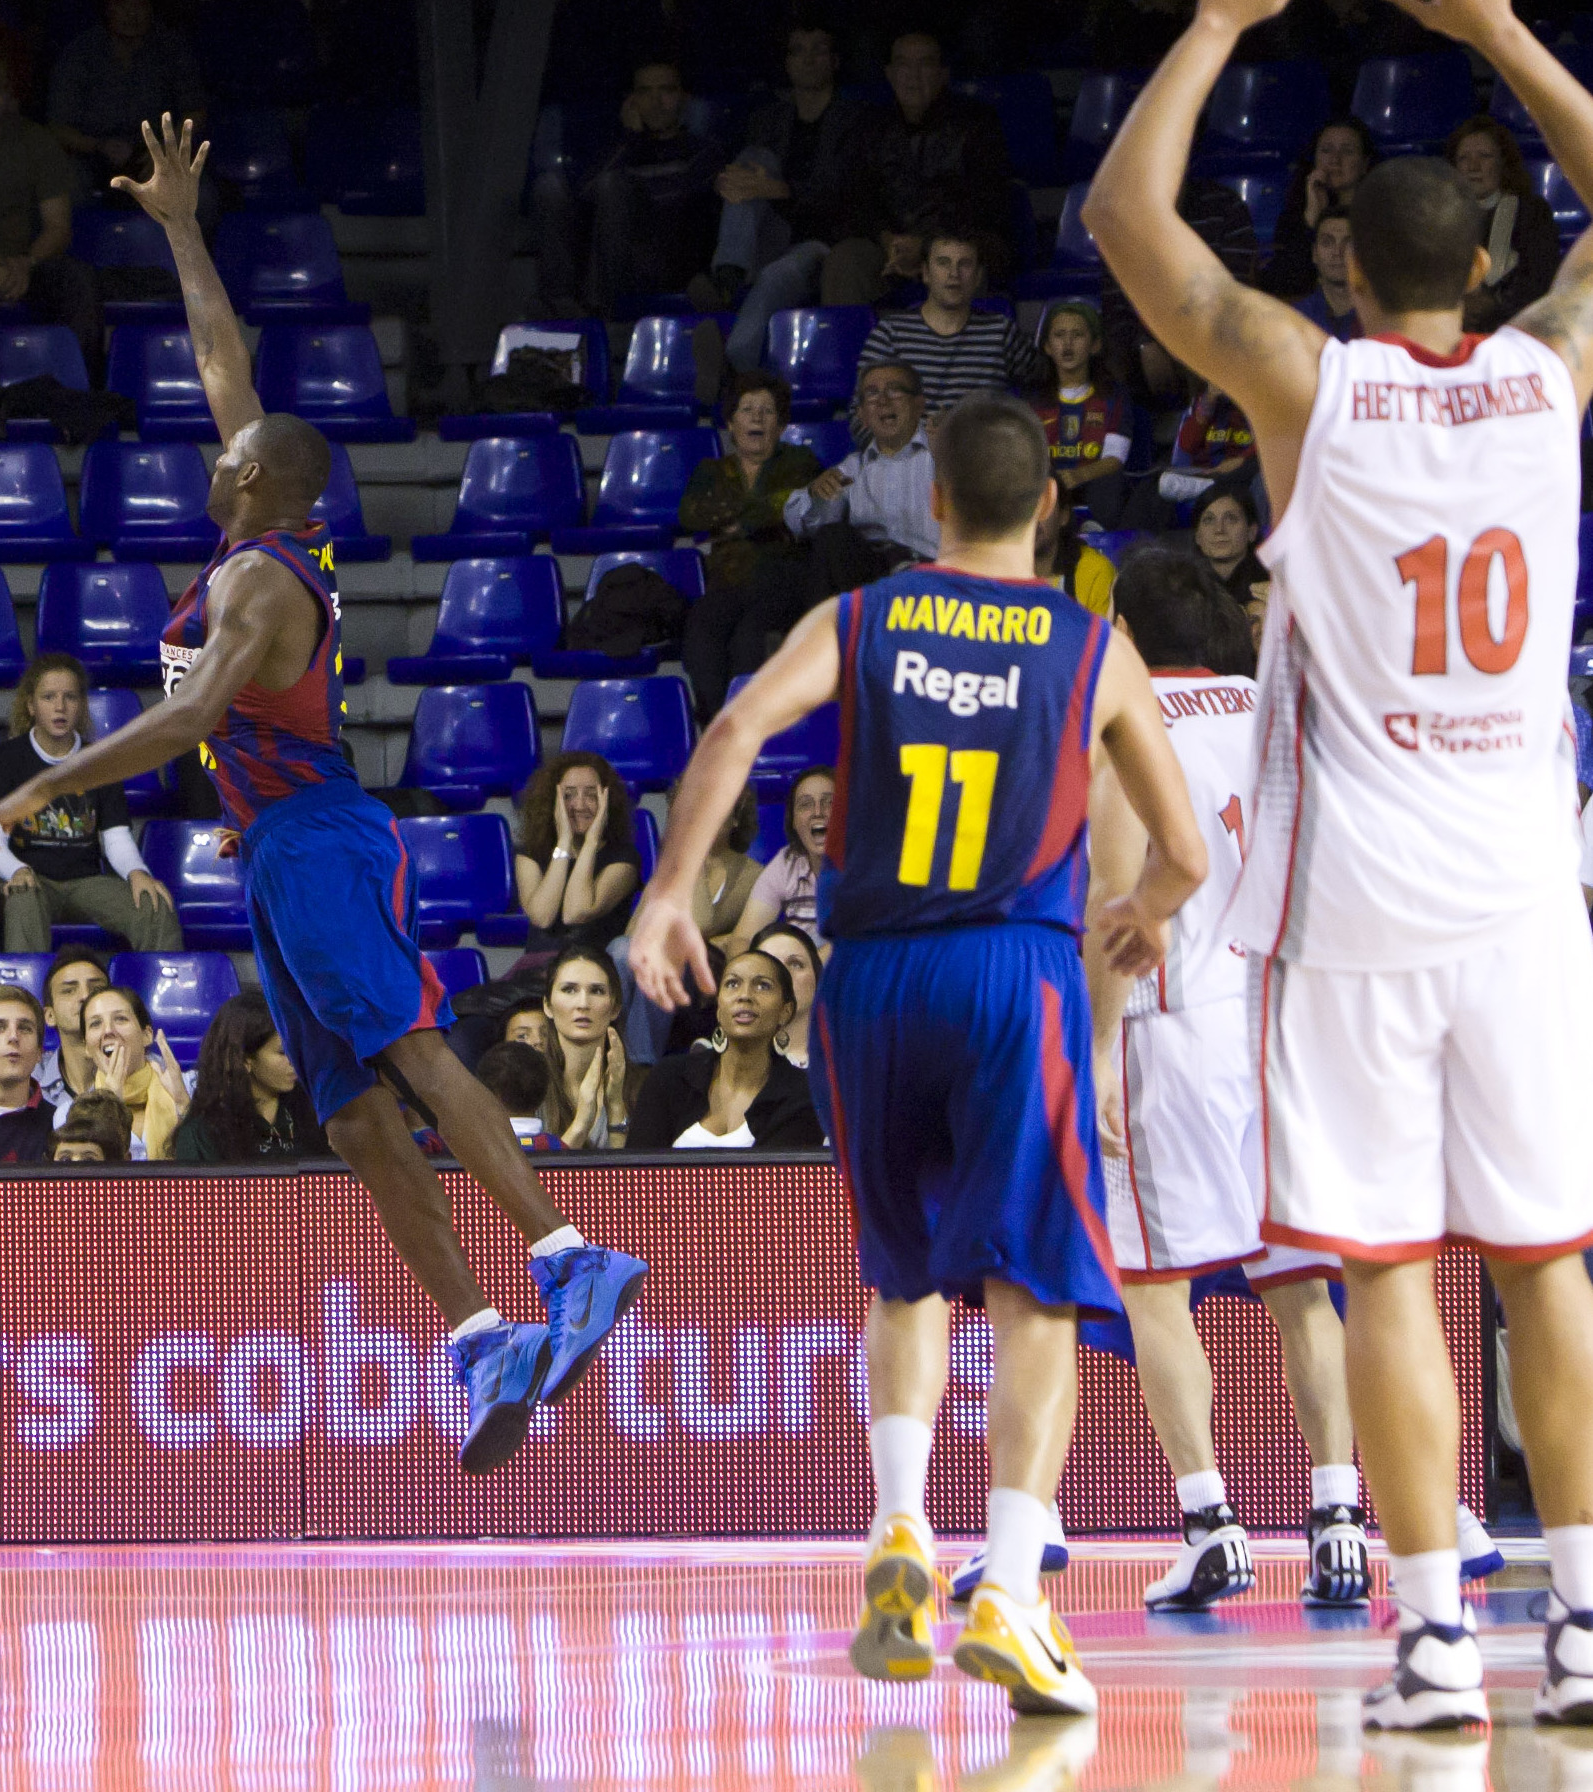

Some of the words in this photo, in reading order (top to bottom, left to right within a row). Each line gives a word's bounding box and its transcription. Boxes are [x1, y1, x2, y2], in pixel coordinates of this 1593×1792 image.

[886, 595, 1052, 646] NAVARRO
[1394, 526, 1530, 677] 10
[893, 650, 1020, 717] Regal
[897, 743, 999, 891] 11
